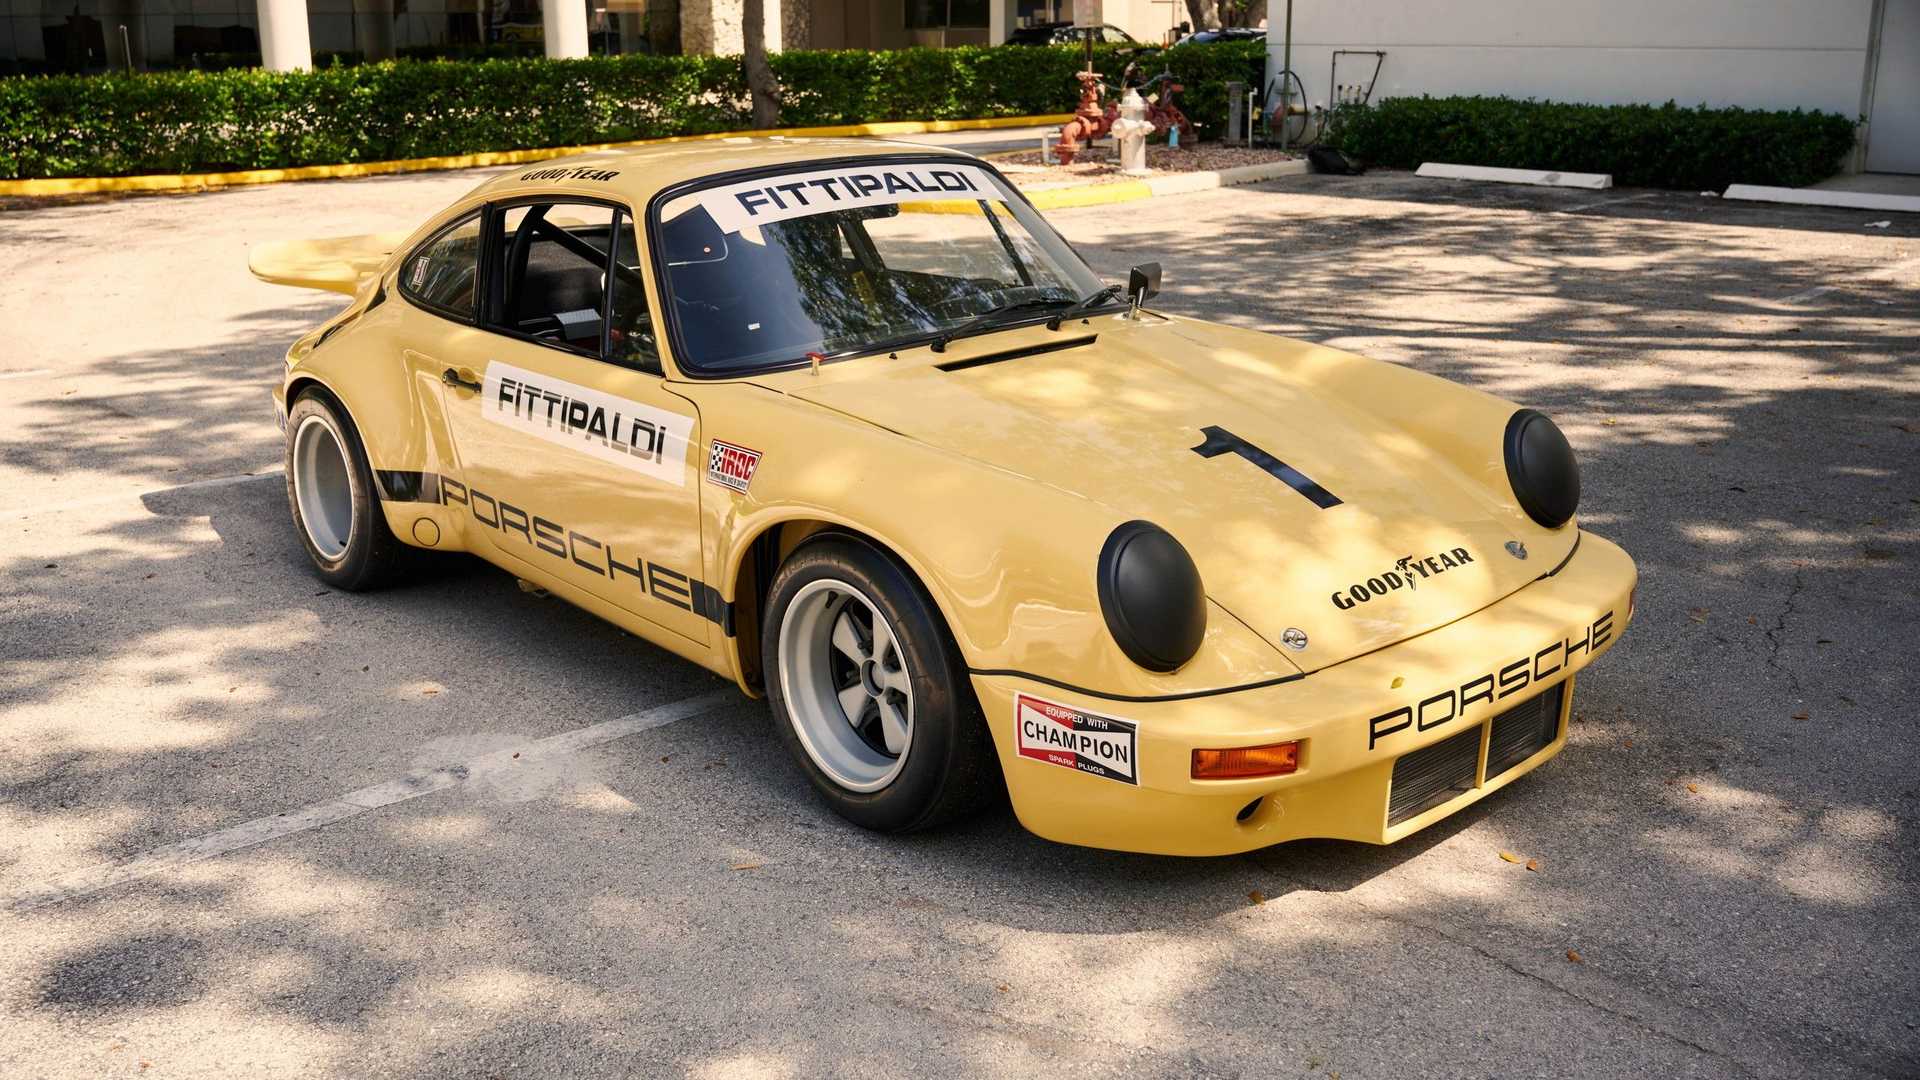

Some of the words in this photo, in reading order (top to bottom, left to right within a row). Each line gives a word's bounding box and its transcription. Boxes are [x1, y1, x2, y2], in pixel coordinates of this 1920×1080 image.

[733, 170, 977, 216] FITTIPALDI
[498, 377, 666, 464] FITTIPALDI
[721, 448, 757, 480] IROC
[1190, 425, 1344, 510] 1
[440, 475, 692, 612] PORSCHE
[1368, 610, 1614, 751] PORSCHE
[1046, 706, 1083, 724] EQUIPPED
[1087, 717, 1108, 730] WITH
[1024, 720, 1128, 763] CHAMPION
[1048, 754, 1074, 767] SPARK
[1077, 762, 1105, 775] PLUGS
